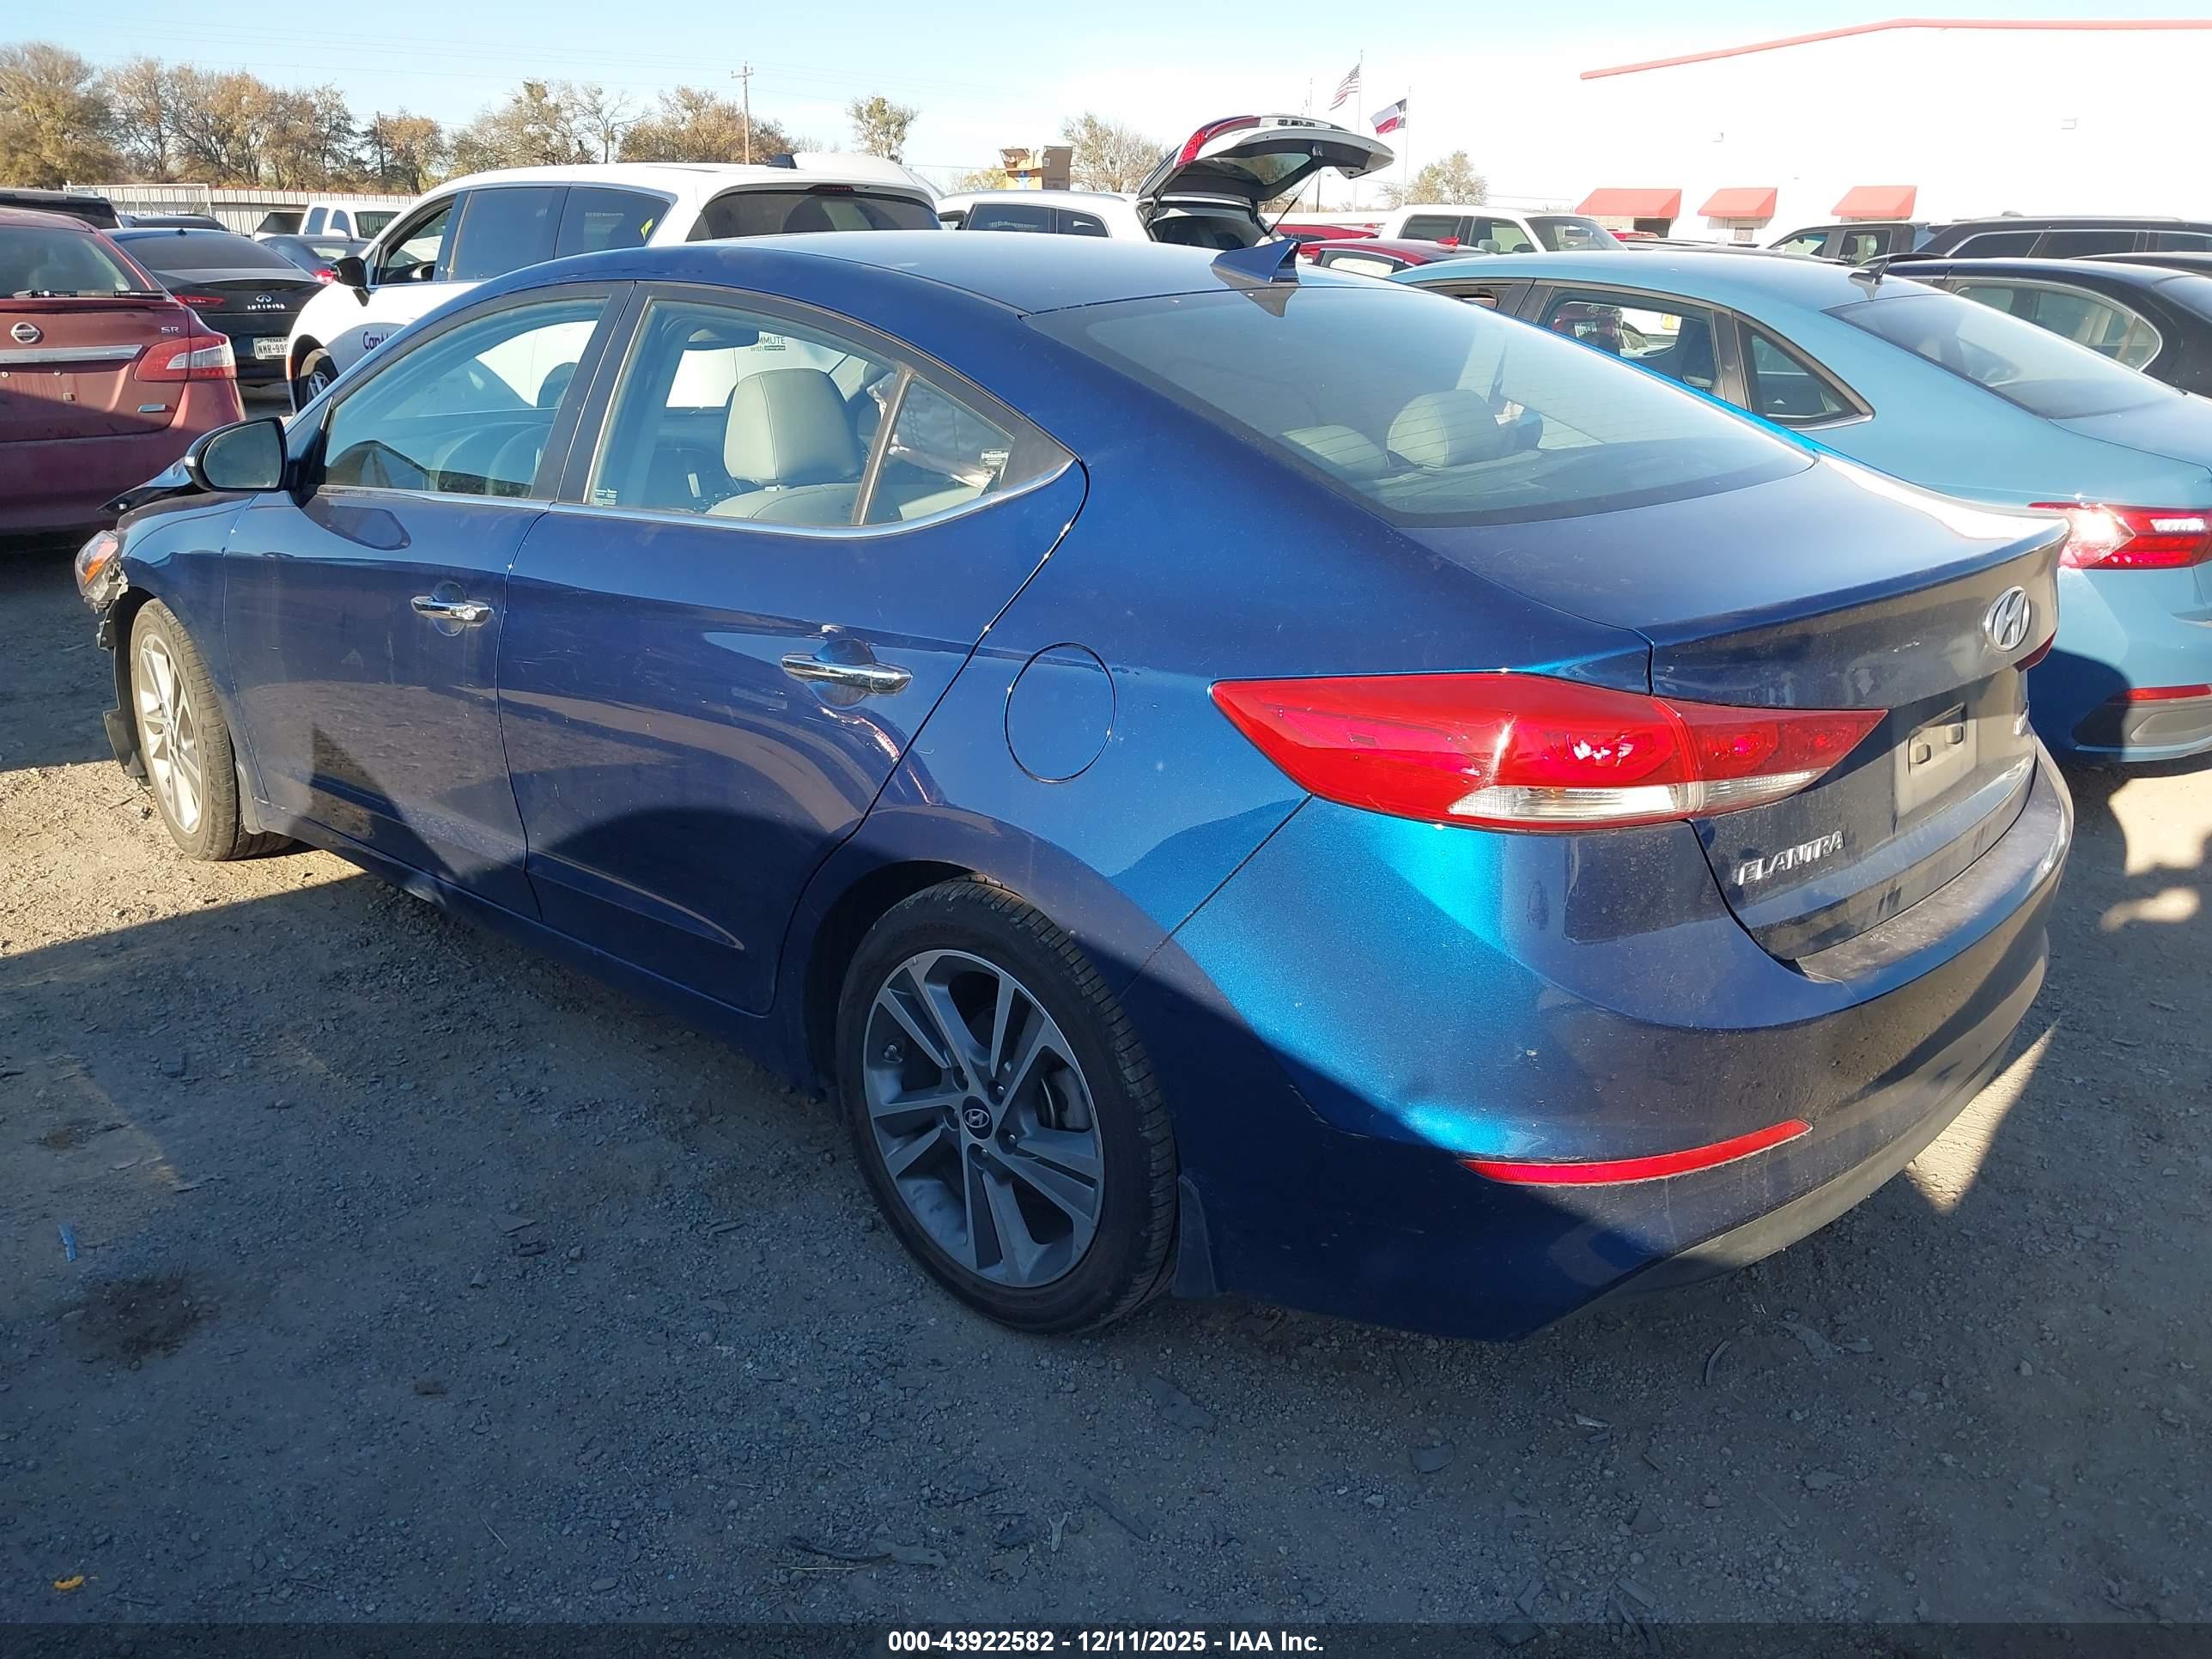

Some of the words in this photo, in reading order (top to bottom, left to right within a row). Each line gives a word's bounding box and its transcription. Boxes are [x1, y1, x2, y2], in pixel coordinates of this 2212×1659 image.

[161, 325, 179, 334] SR
[750, 343, 764, 353] with
[1737, 830, 1845, 887] ELANTRA
